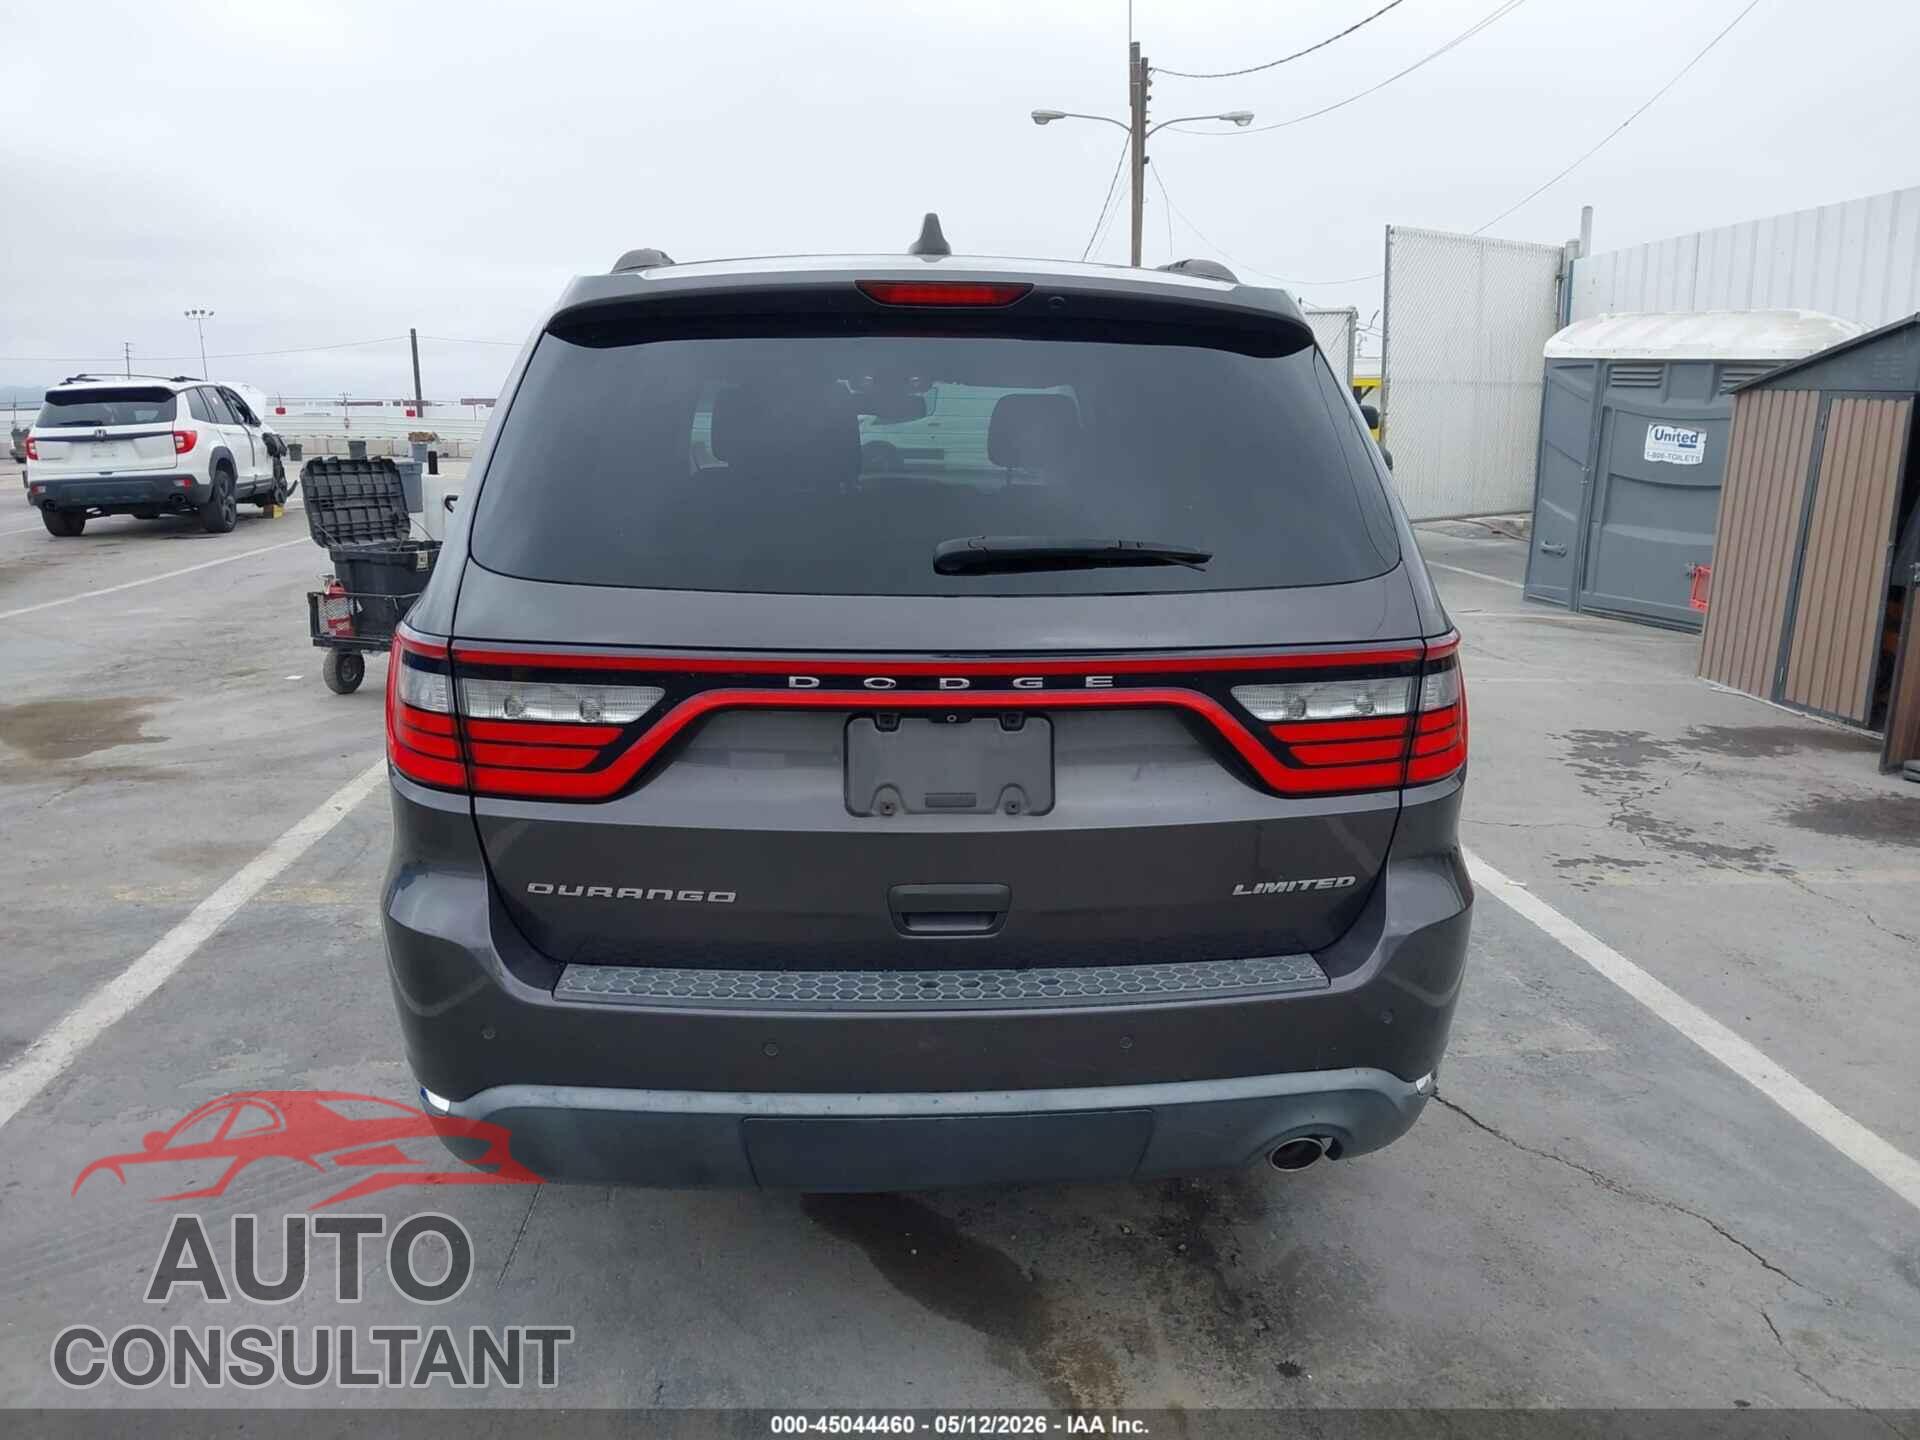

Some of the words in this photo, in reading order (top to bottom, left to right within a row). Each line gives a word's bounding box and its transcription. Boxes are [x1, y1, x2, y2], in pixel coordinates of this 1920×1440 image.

[1654, 428, 1698, 443] United
[788, 675, 1115, 690] DODGE
[527, 882, 737, 903] DURANGO
[1232, 876, 1356, 896] LIMITED
